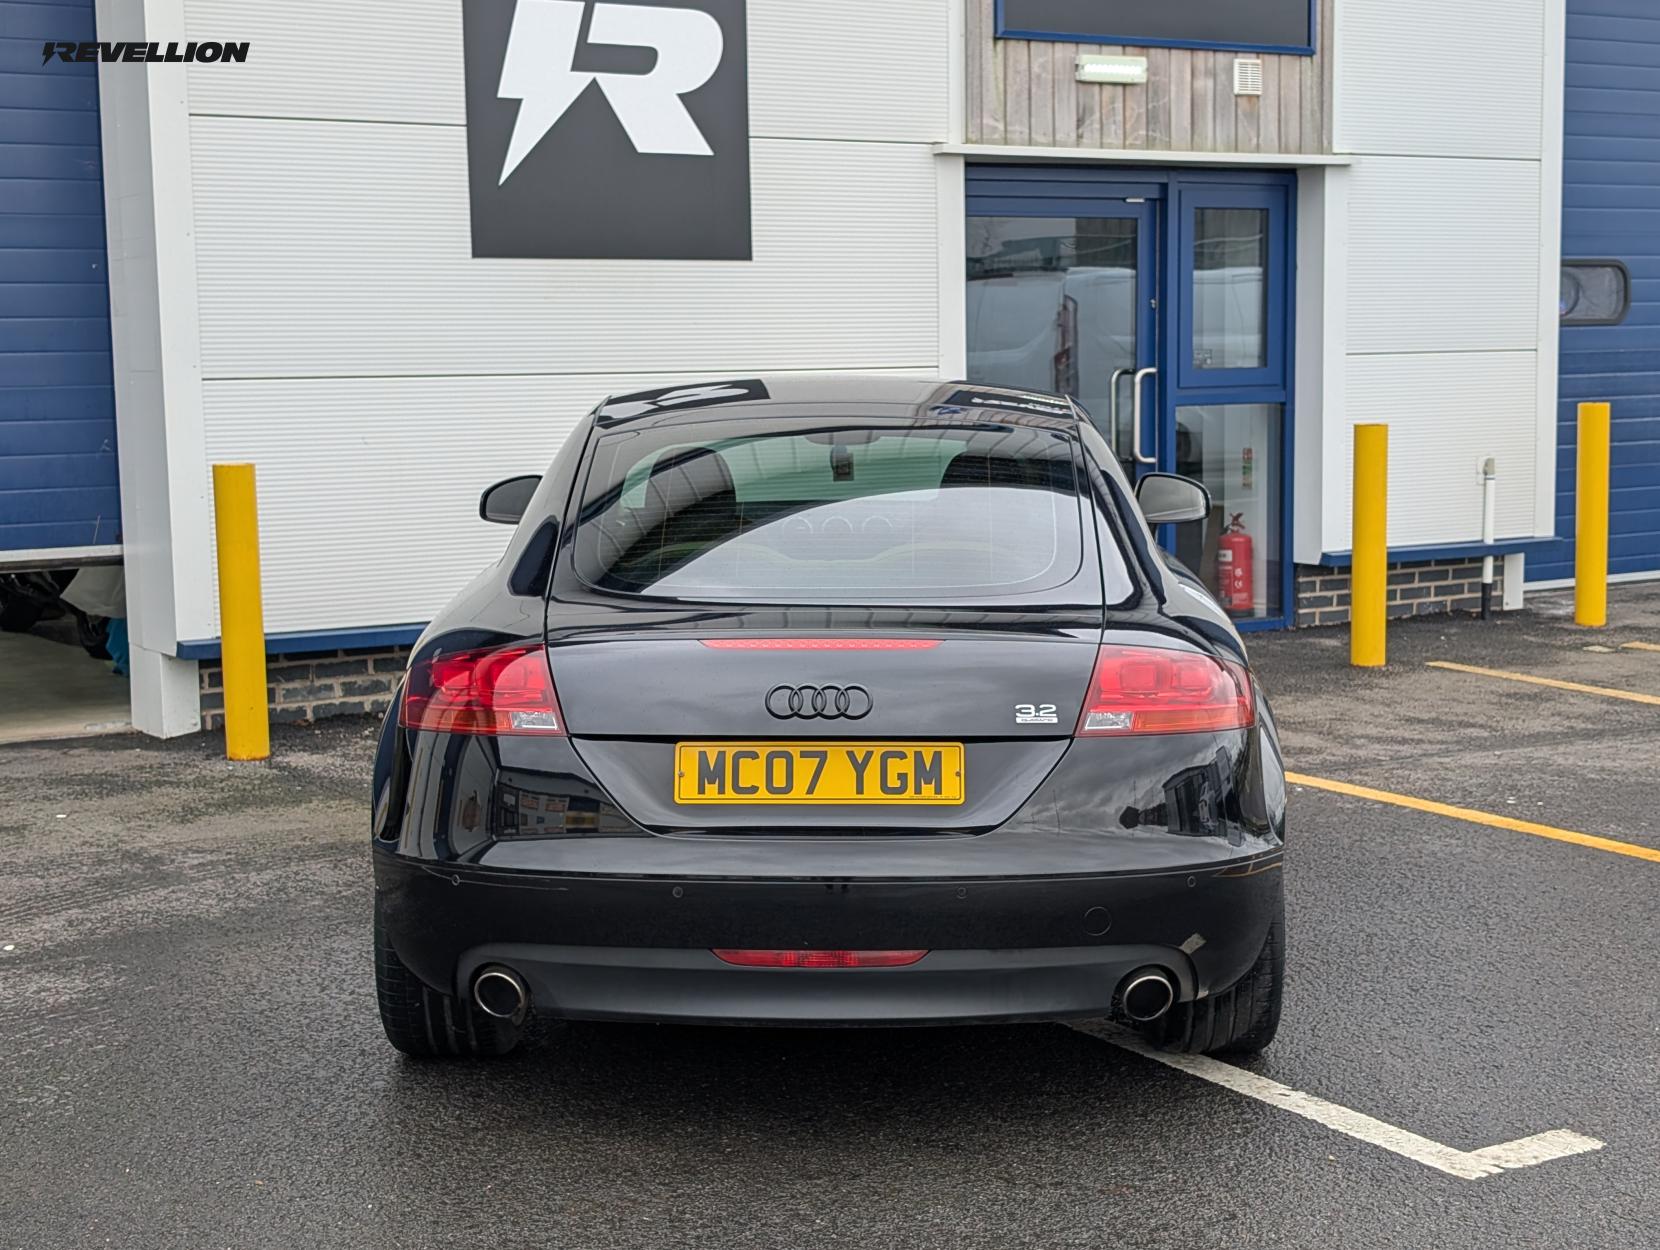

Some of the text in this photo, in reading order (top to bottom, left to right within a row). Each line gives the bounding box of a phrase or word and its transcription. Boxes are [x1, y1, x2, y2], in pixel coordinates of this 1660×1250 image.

[1015, 704, 1057, 717] 3.2
[697, 750, 943, 795] MC07 YGM
